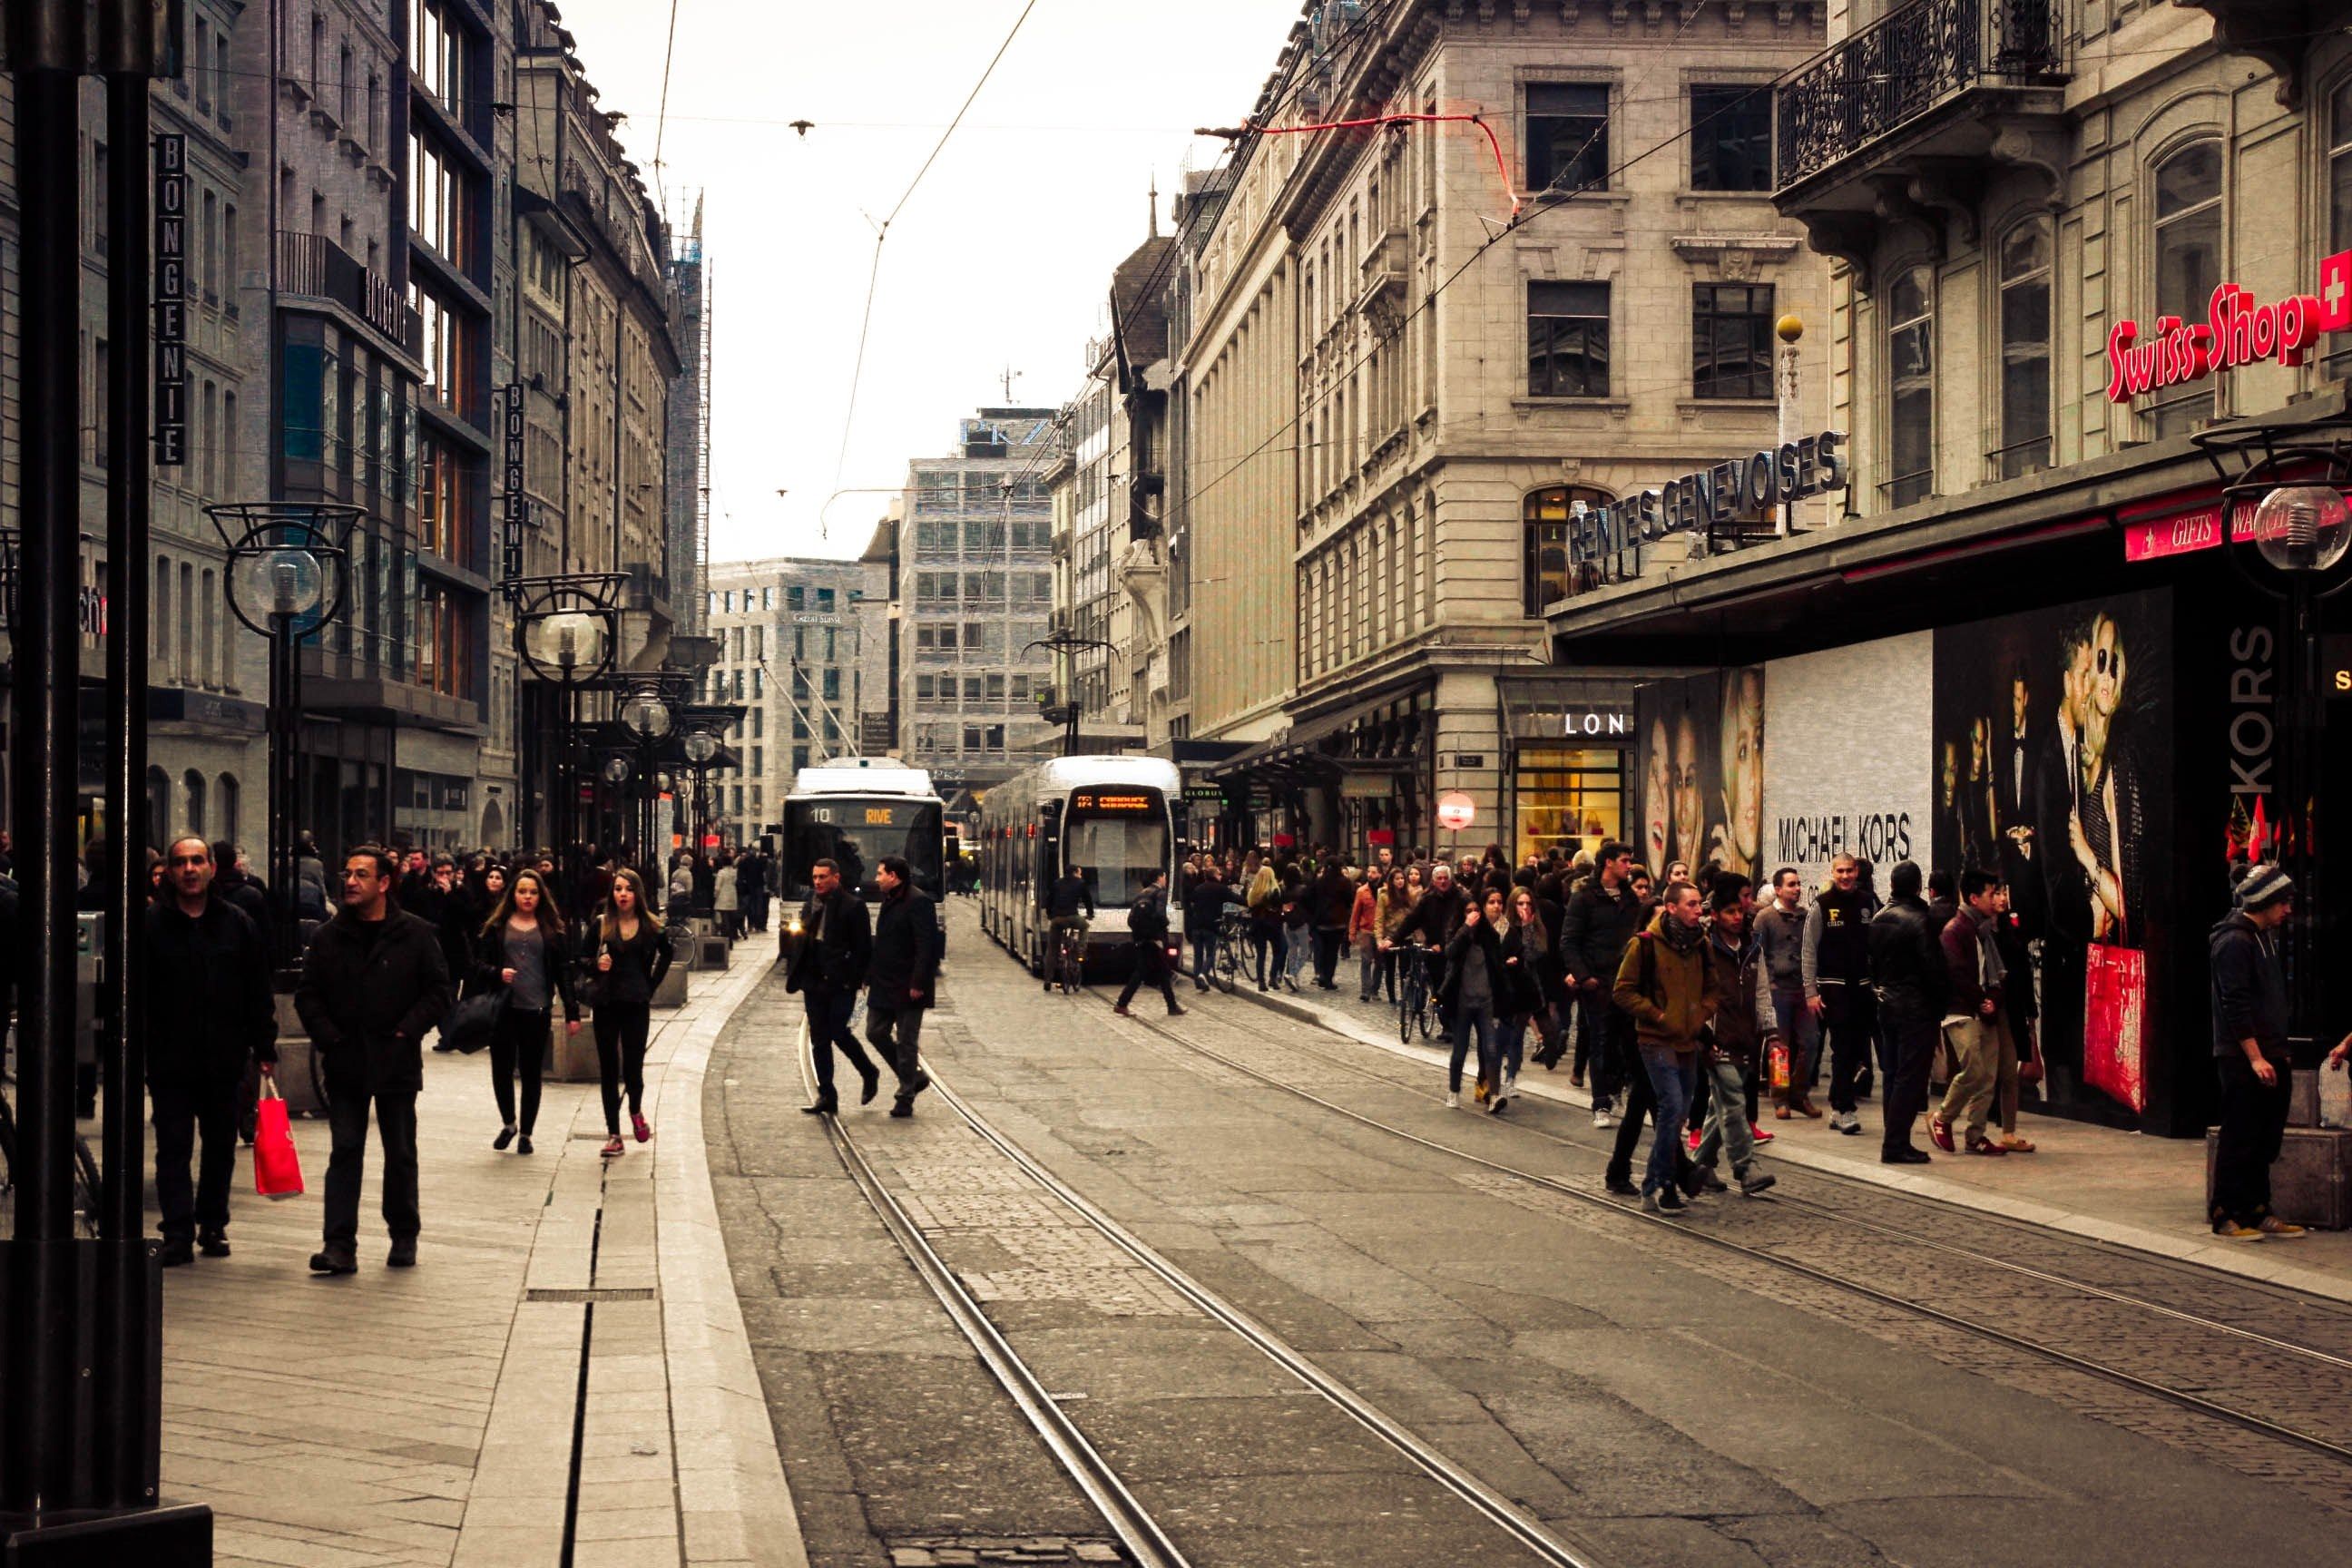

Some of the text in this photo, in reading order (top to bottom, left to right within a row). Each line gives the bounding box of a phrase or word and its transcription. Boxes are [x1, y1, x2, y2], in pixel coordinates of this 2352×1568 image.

[164, 138, 179, 461] BONGENIE
[2107, 282, 2320, 404] Swiss Shop
[1567, 430, 1848, 567] RENTES GENEVOISES
[2172, 514, 2213, 547] GIFTS
[1564, 712, 1634, 734] LON
[2230, 625, 2273, 793] KORS
[811, 808, 893, 824] 10 RIVE
[1779, 811, 1910, 863] MICHAEL KORS
